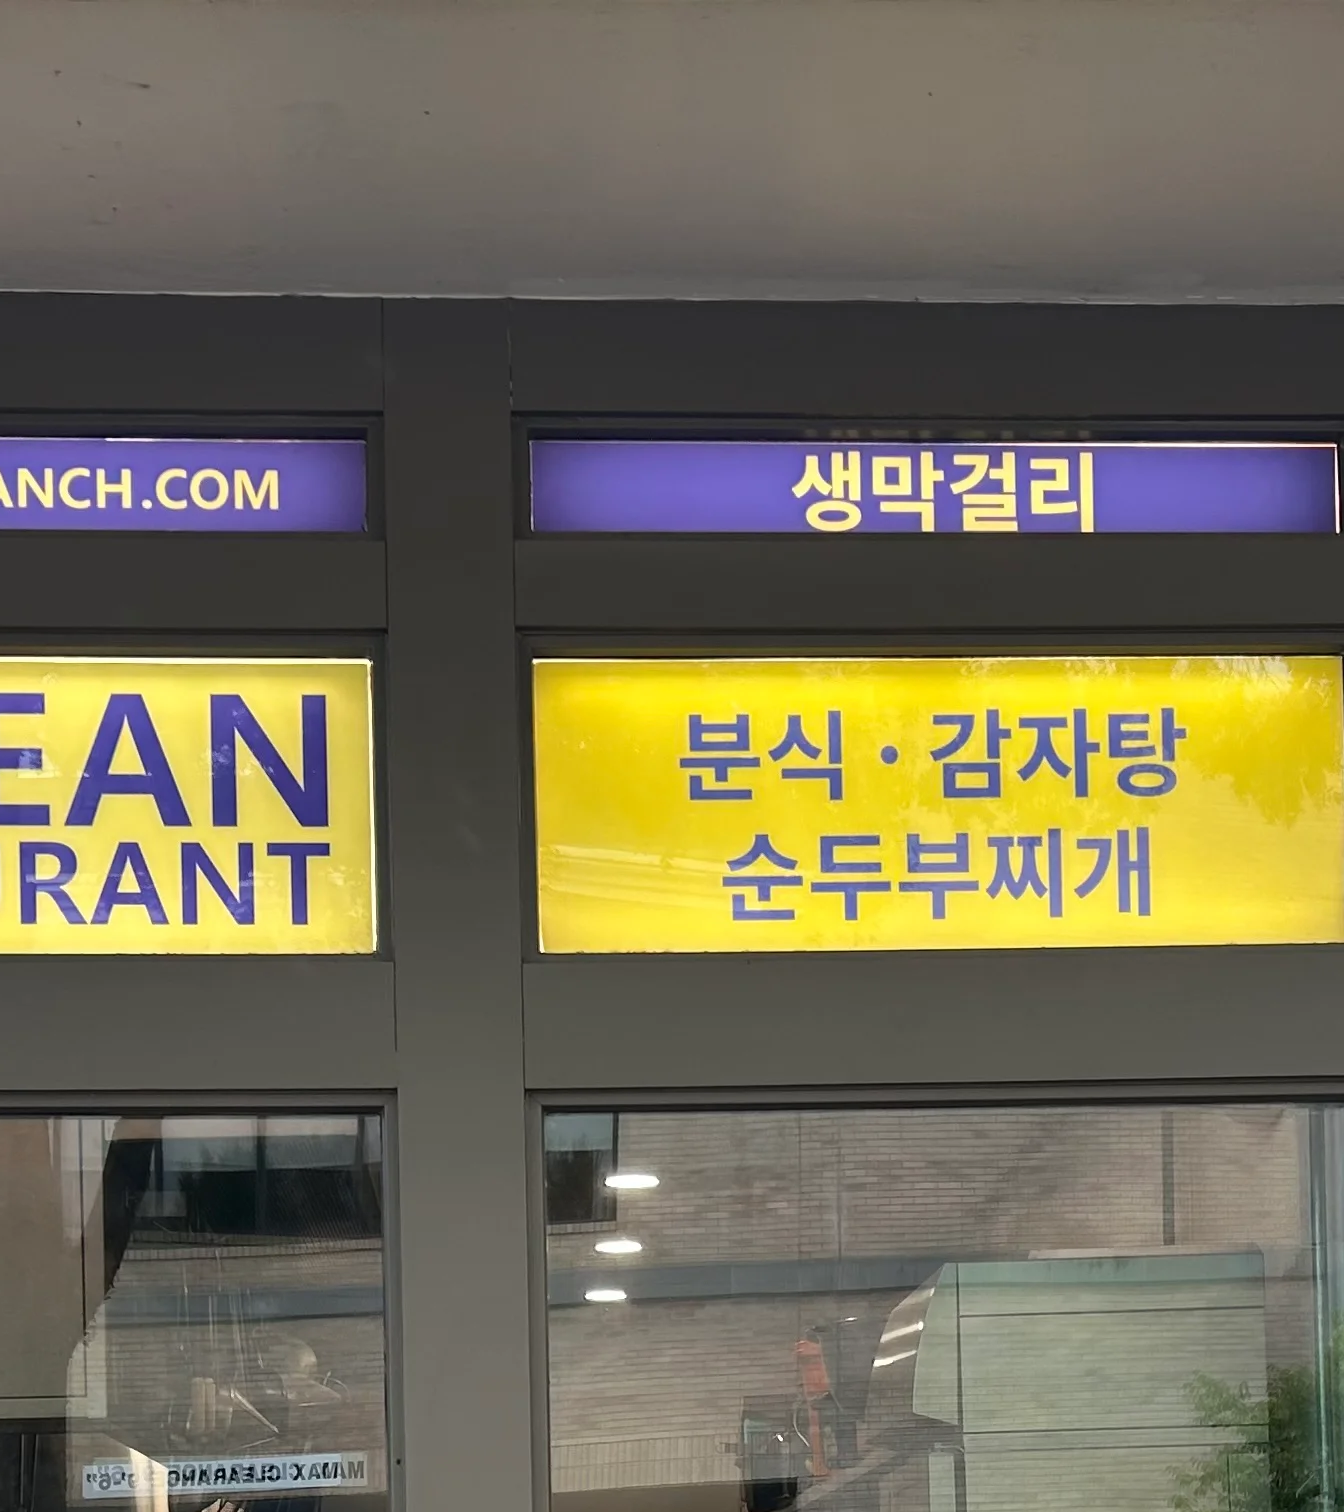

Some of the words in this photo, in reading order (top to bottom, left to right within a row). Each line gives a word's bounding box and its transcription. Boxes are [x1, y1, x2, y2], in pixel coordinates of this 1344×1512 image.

[792, 451, 1096, 533] 생막걸리
[679, 709, 844, 801] 분식
[930, 707, 1187, 799] 감자탕
[722, 826, 1151, 921] 순두부찌개
